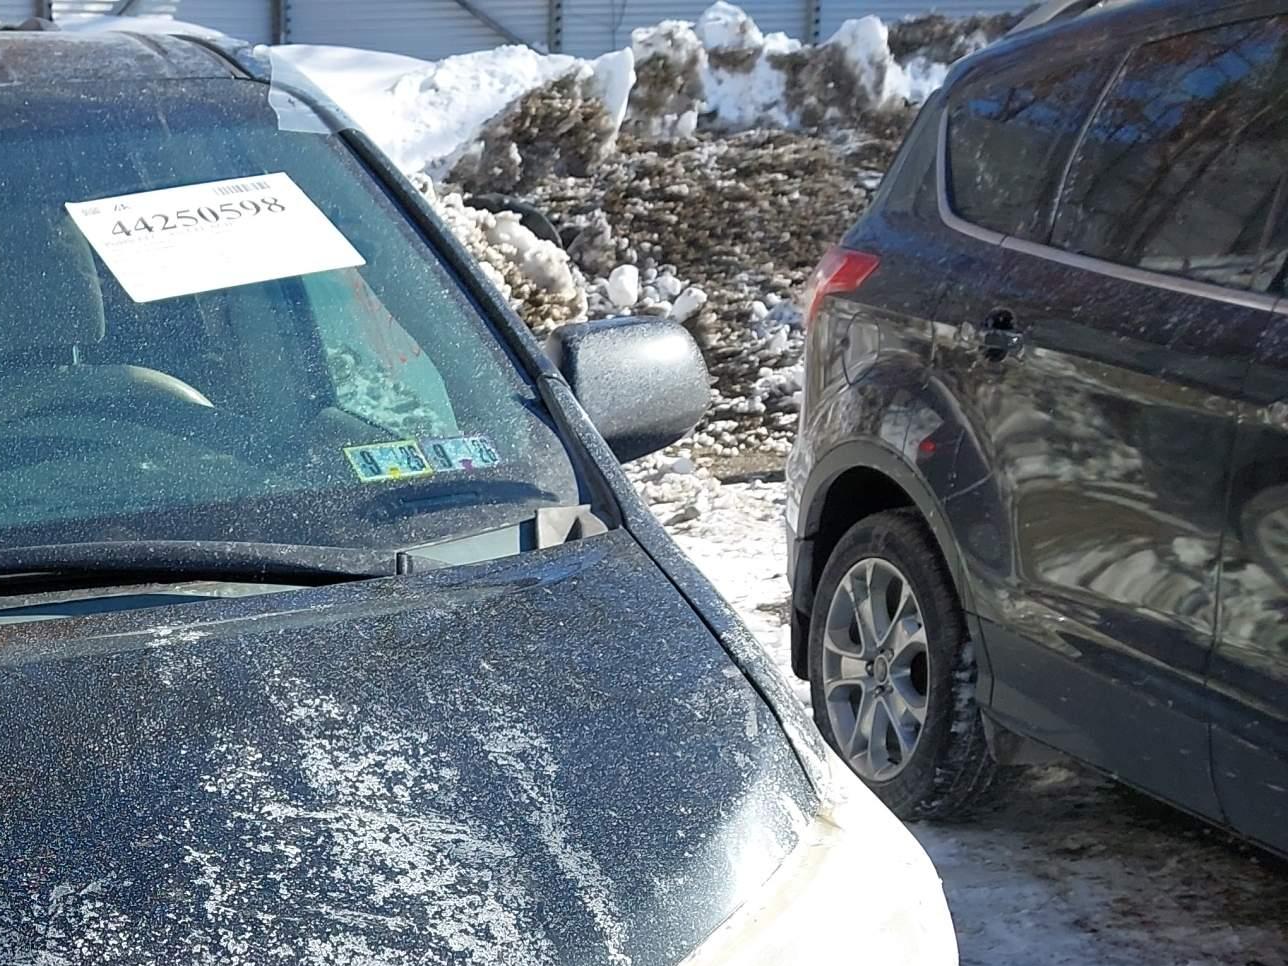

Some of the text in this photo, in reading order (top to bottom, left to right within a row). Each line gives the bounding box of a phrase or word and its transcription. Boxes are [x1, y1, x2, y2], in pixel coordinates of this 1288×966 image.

[111, 197, 286, 237] 44250598
[360, 450, 382, 476] 9
[432, 442, 453, 469] 9
